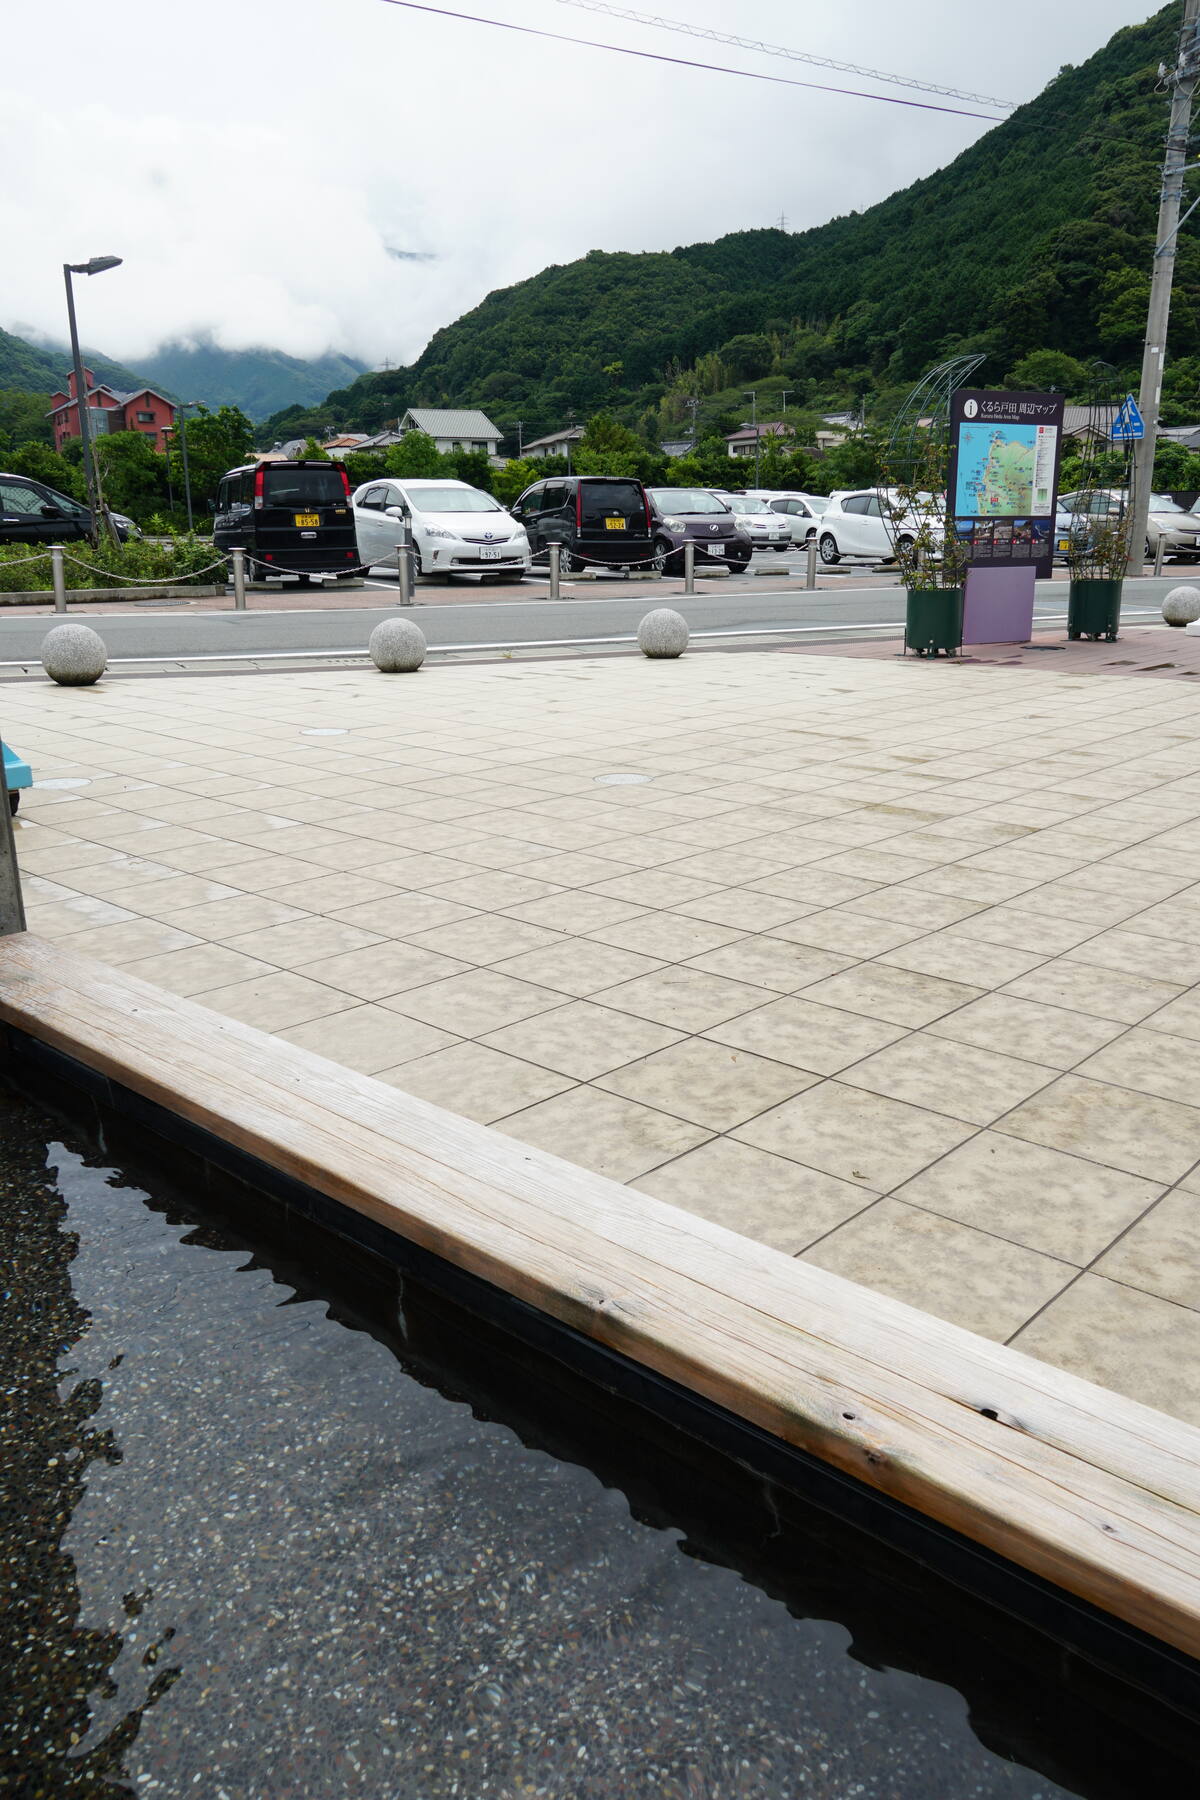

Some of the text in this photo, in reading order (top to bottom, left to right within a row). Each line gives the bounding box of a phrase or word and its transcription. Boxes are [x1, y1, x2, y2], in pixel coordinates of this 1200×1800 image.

[981, 401, 1057, 415] くるら戸田 周辺マップ
